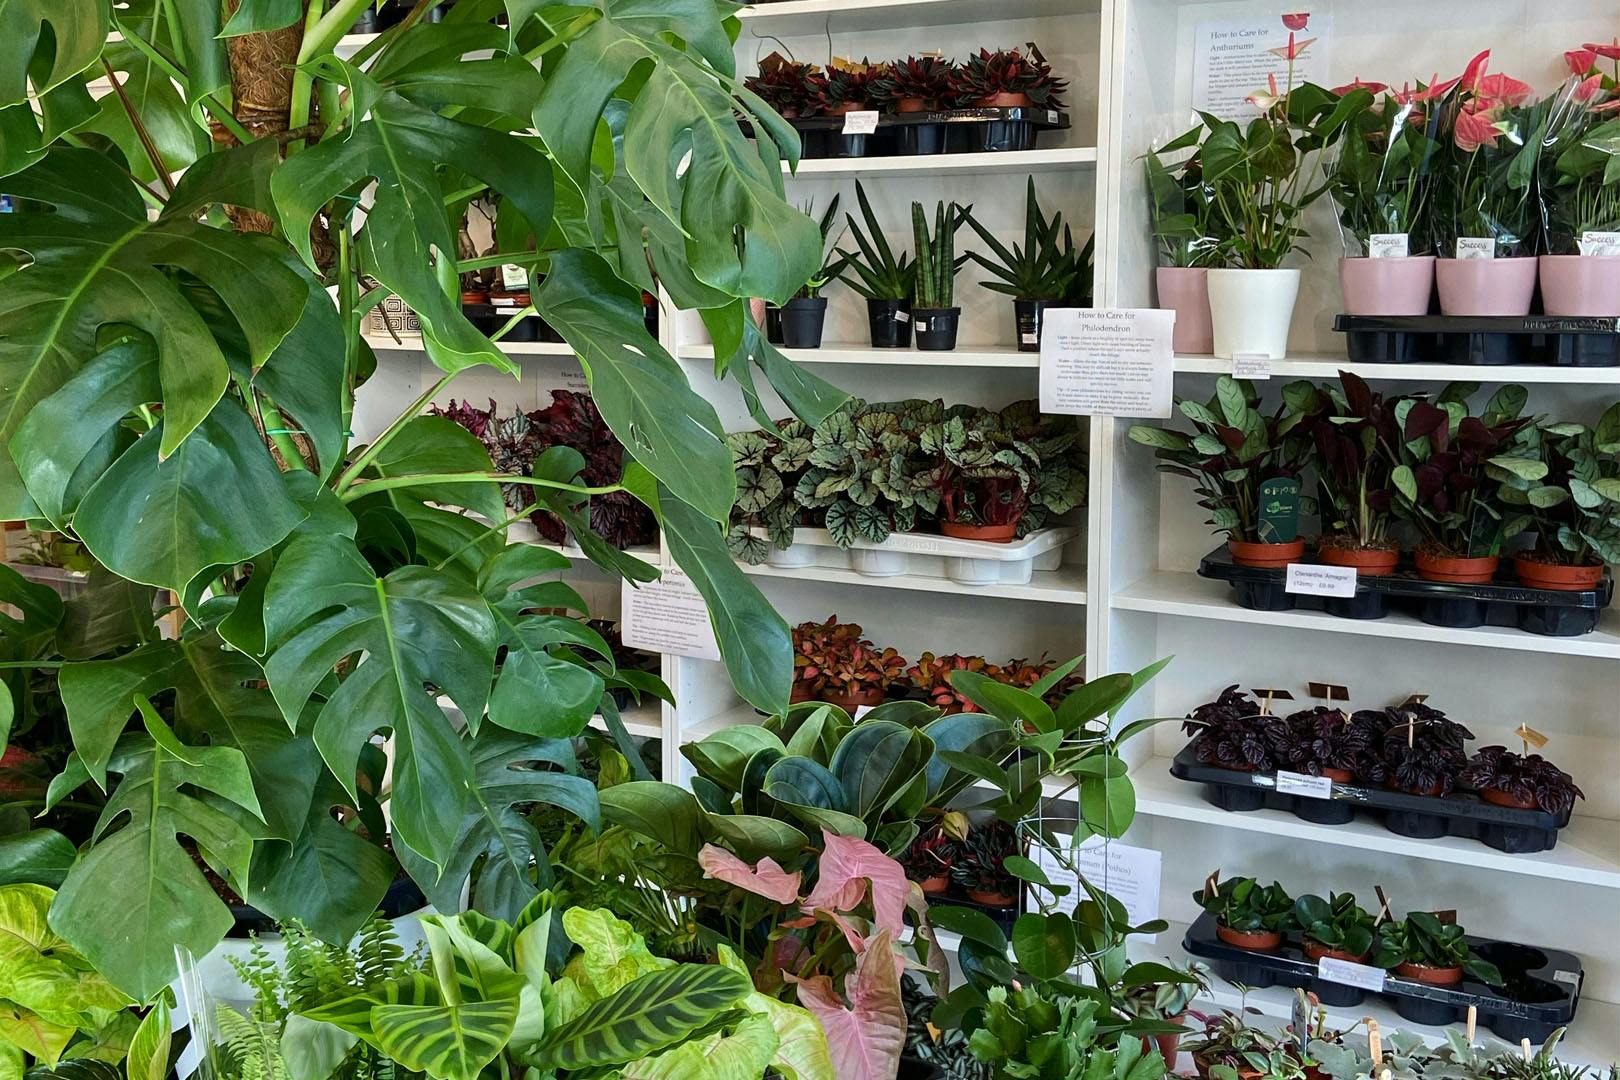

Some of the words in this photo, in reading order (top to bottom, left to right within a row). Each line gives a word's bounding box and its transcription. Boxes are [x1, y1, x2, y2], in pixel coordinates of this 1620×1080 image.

[1210, 31, 1227, 39] How
[1210, 43, 1254, 52] Anthuriums
[1373, 237, 1400, 246] Success
[1585, 233, 1615, 244] Success
[1459, 239, 1487, 249] Success
[1078, 311, 1095, 319] How
[1106, 311, 1123, 319] Care
[1125, 311, 1136, 319] for
[1081, 323, 1131, 332] Philodendron
[1111, 852, 1122, 860] for
